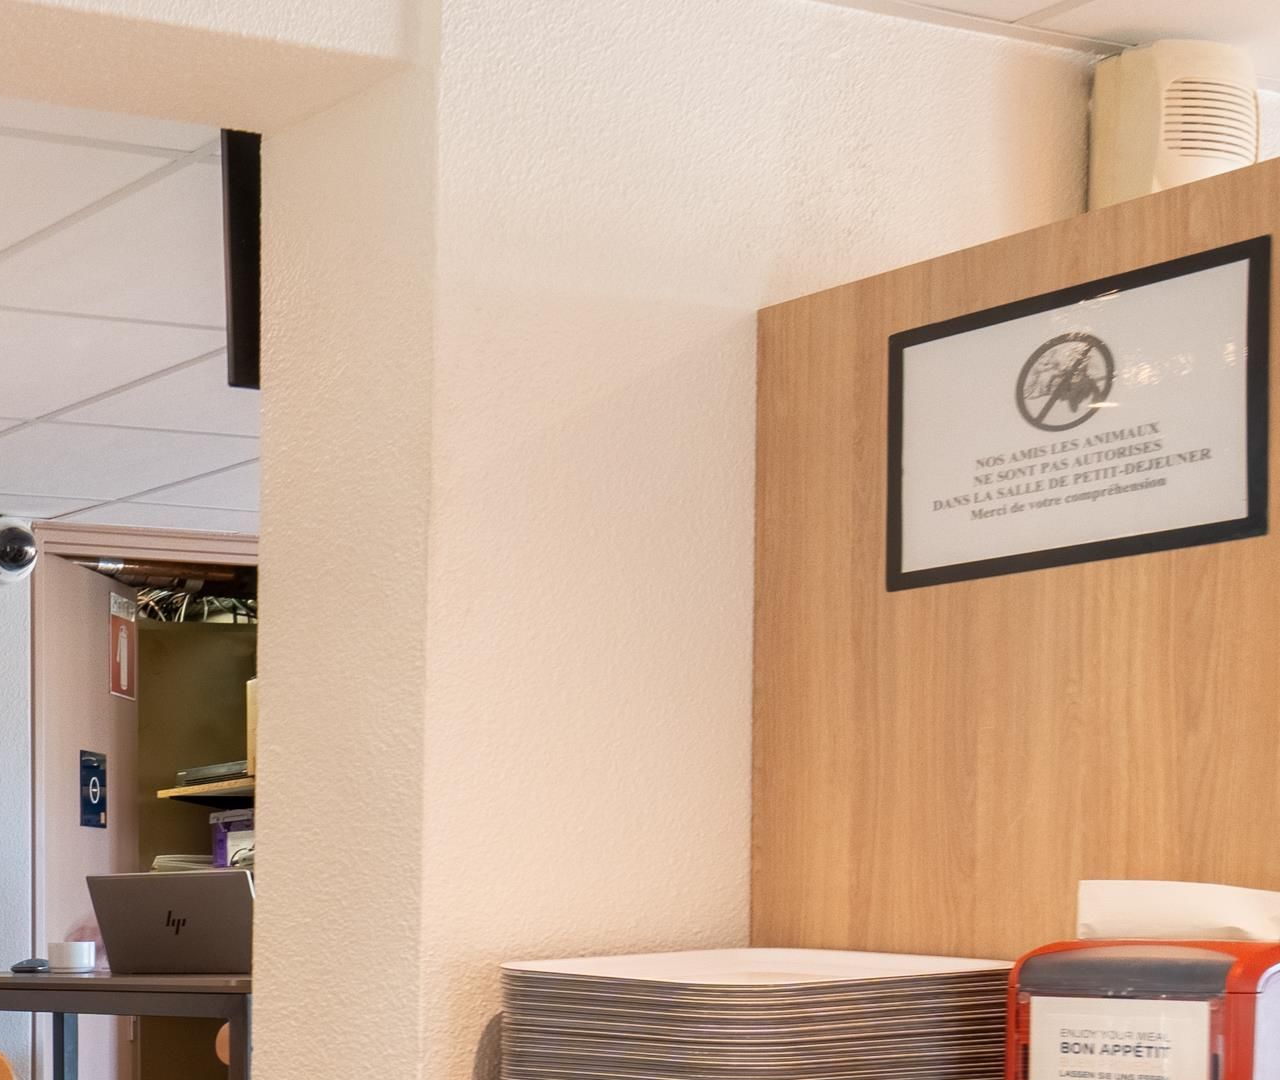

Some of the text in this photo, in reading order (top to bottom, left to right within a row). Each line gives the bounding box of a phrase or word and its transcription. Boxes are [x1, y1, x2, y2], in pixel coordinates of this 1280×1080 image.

[973, 438, 1162, 486] NE SONT PAS AUTORISES
[976, 421, 1161, 470] NOS AMIS LES ANIMAUX
[933, 447, 1212, 512] DANS LA SALLE DE PETIT-DEJEUNER
[971, 476, 1167, 521] Merci de votre compréhension
[1060, 1042, 1172, 1059] BON APPÉTIT
